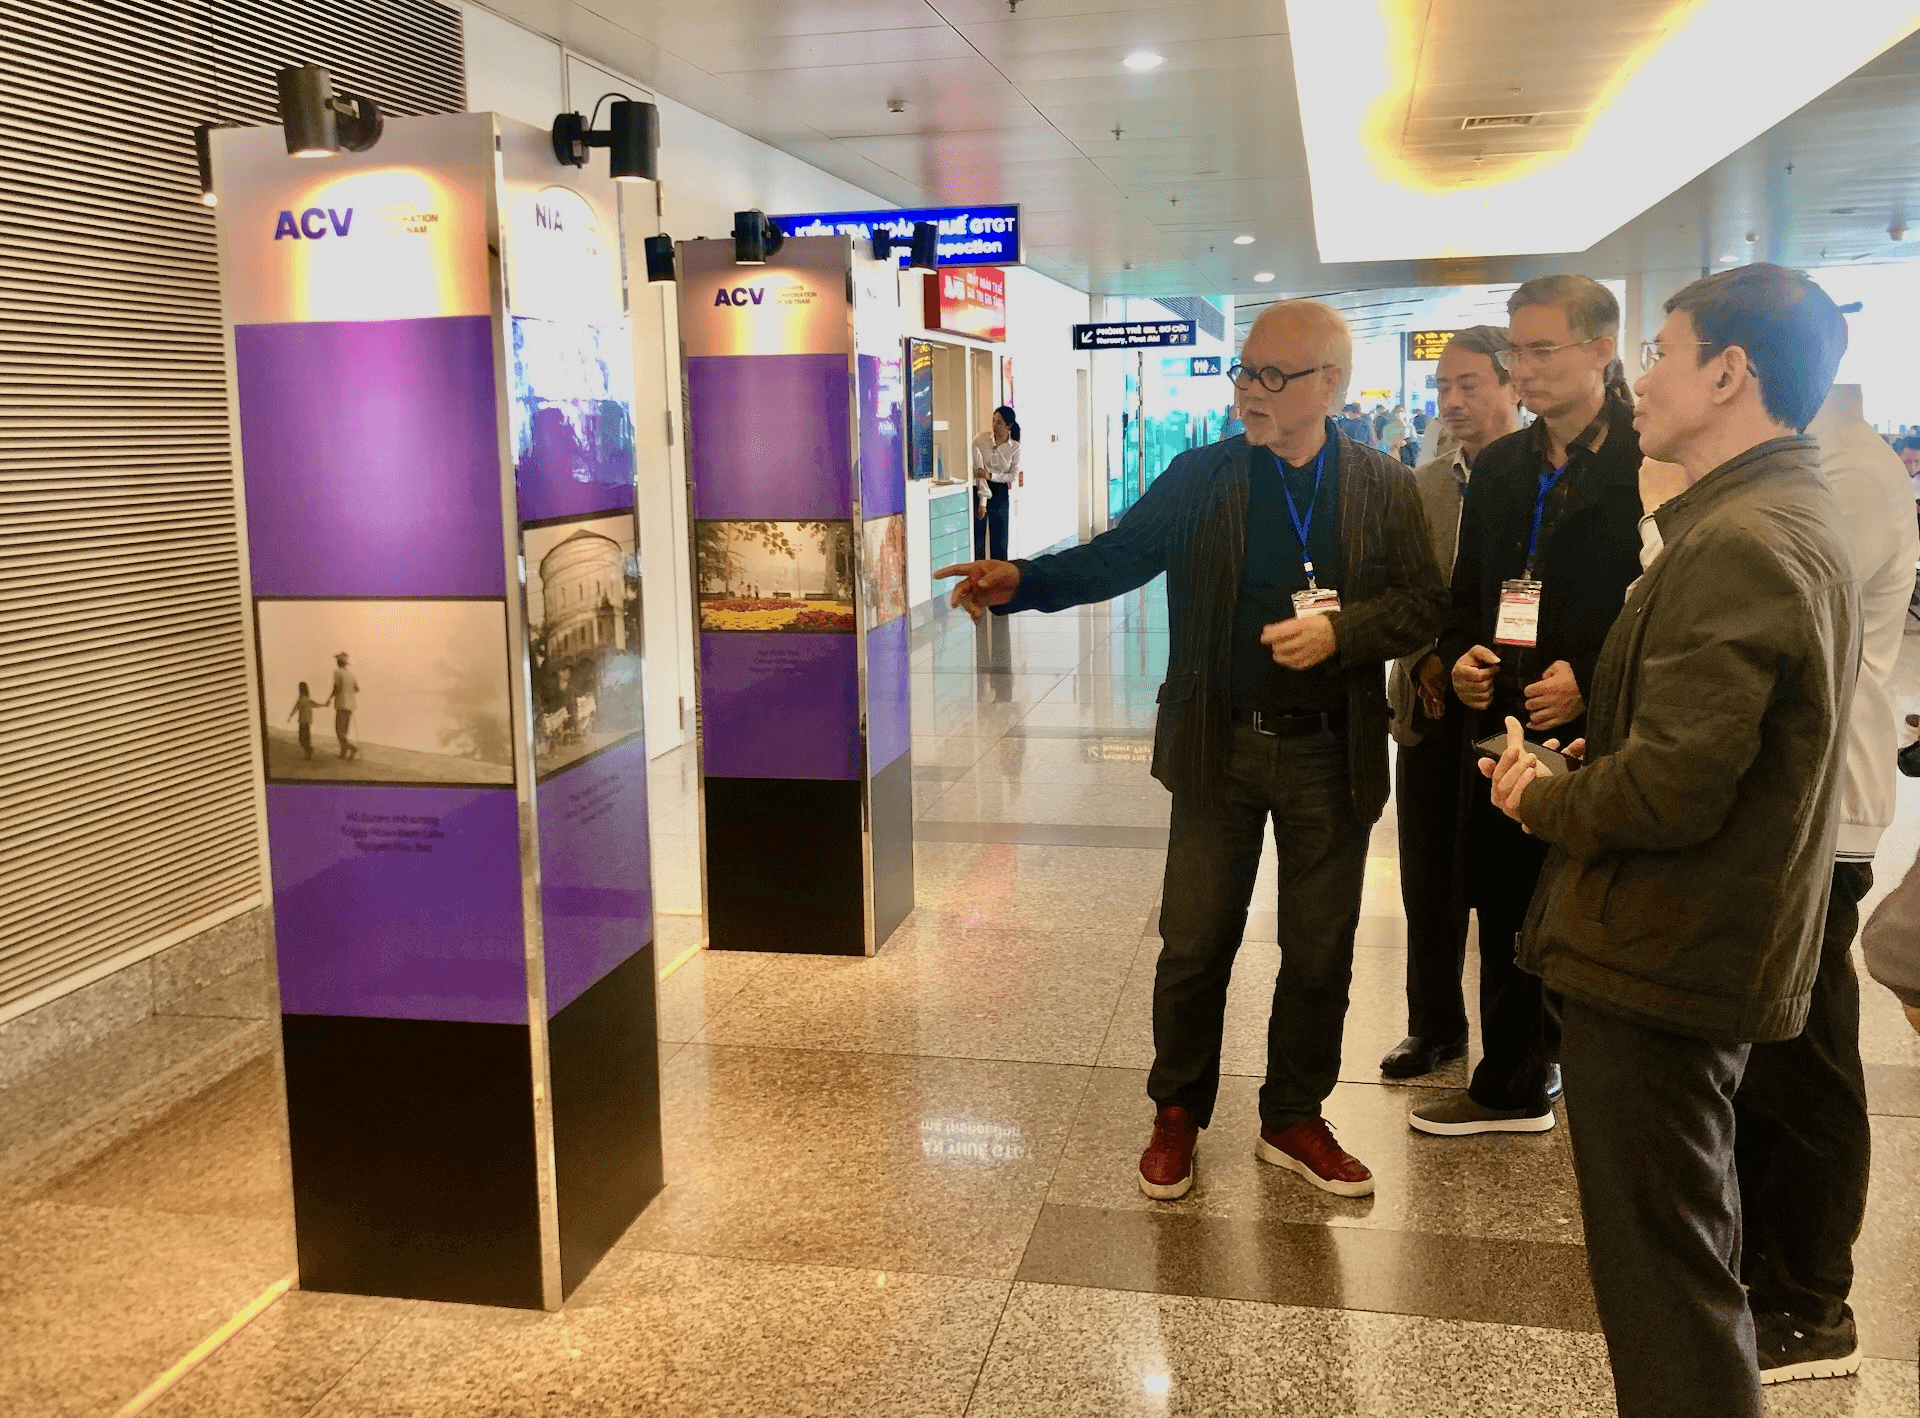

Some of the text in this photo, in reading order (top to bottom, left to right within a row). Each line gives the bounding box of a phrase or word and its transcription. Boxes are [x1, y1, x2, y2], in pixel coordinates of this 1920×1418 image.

[274, 207, 354, 241] ACV
[969, 217, 1016, 234] GTGT
[714, 287, 765, 307] ACV
